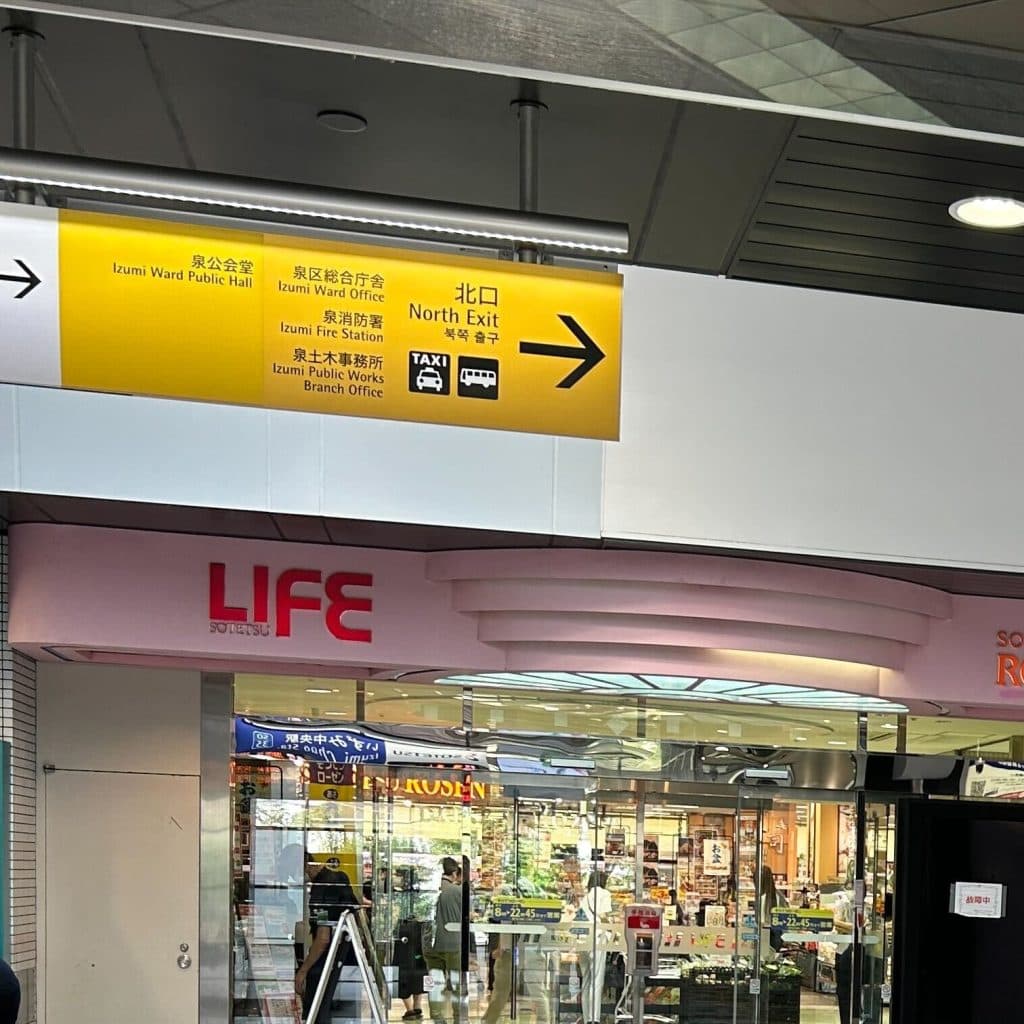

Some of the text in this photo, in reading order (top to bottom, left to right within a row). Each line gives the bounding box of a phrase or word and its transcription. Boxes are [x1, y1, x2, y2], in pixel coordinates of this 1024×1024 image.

[112, 262, 253, 289] Izumi Ward Public Hall
[191, 254, 254, 275] 泉公会堂
[293, 265, 385, 290] 泉区総合庁舎
[278, 280, 385, 303] Izumi Ward Office
[454, 282, 498, 307] 北口
[323, 309, 384, 330] 泉消防署
[409, 303, 500, 328] North Exit
[280, 321, 384, 343] Izumi Fire Station
[292, 347, 384, 371] 泉土木事務所
[411, 352, 448, 368] TAXI
[272, 362, 385, 384] Izumi Public Works
[304, 380, 384, 399] Branch Office
[209, 561, 374, 643] LIFE
[209, 622, 270, 637] SOTETSU
